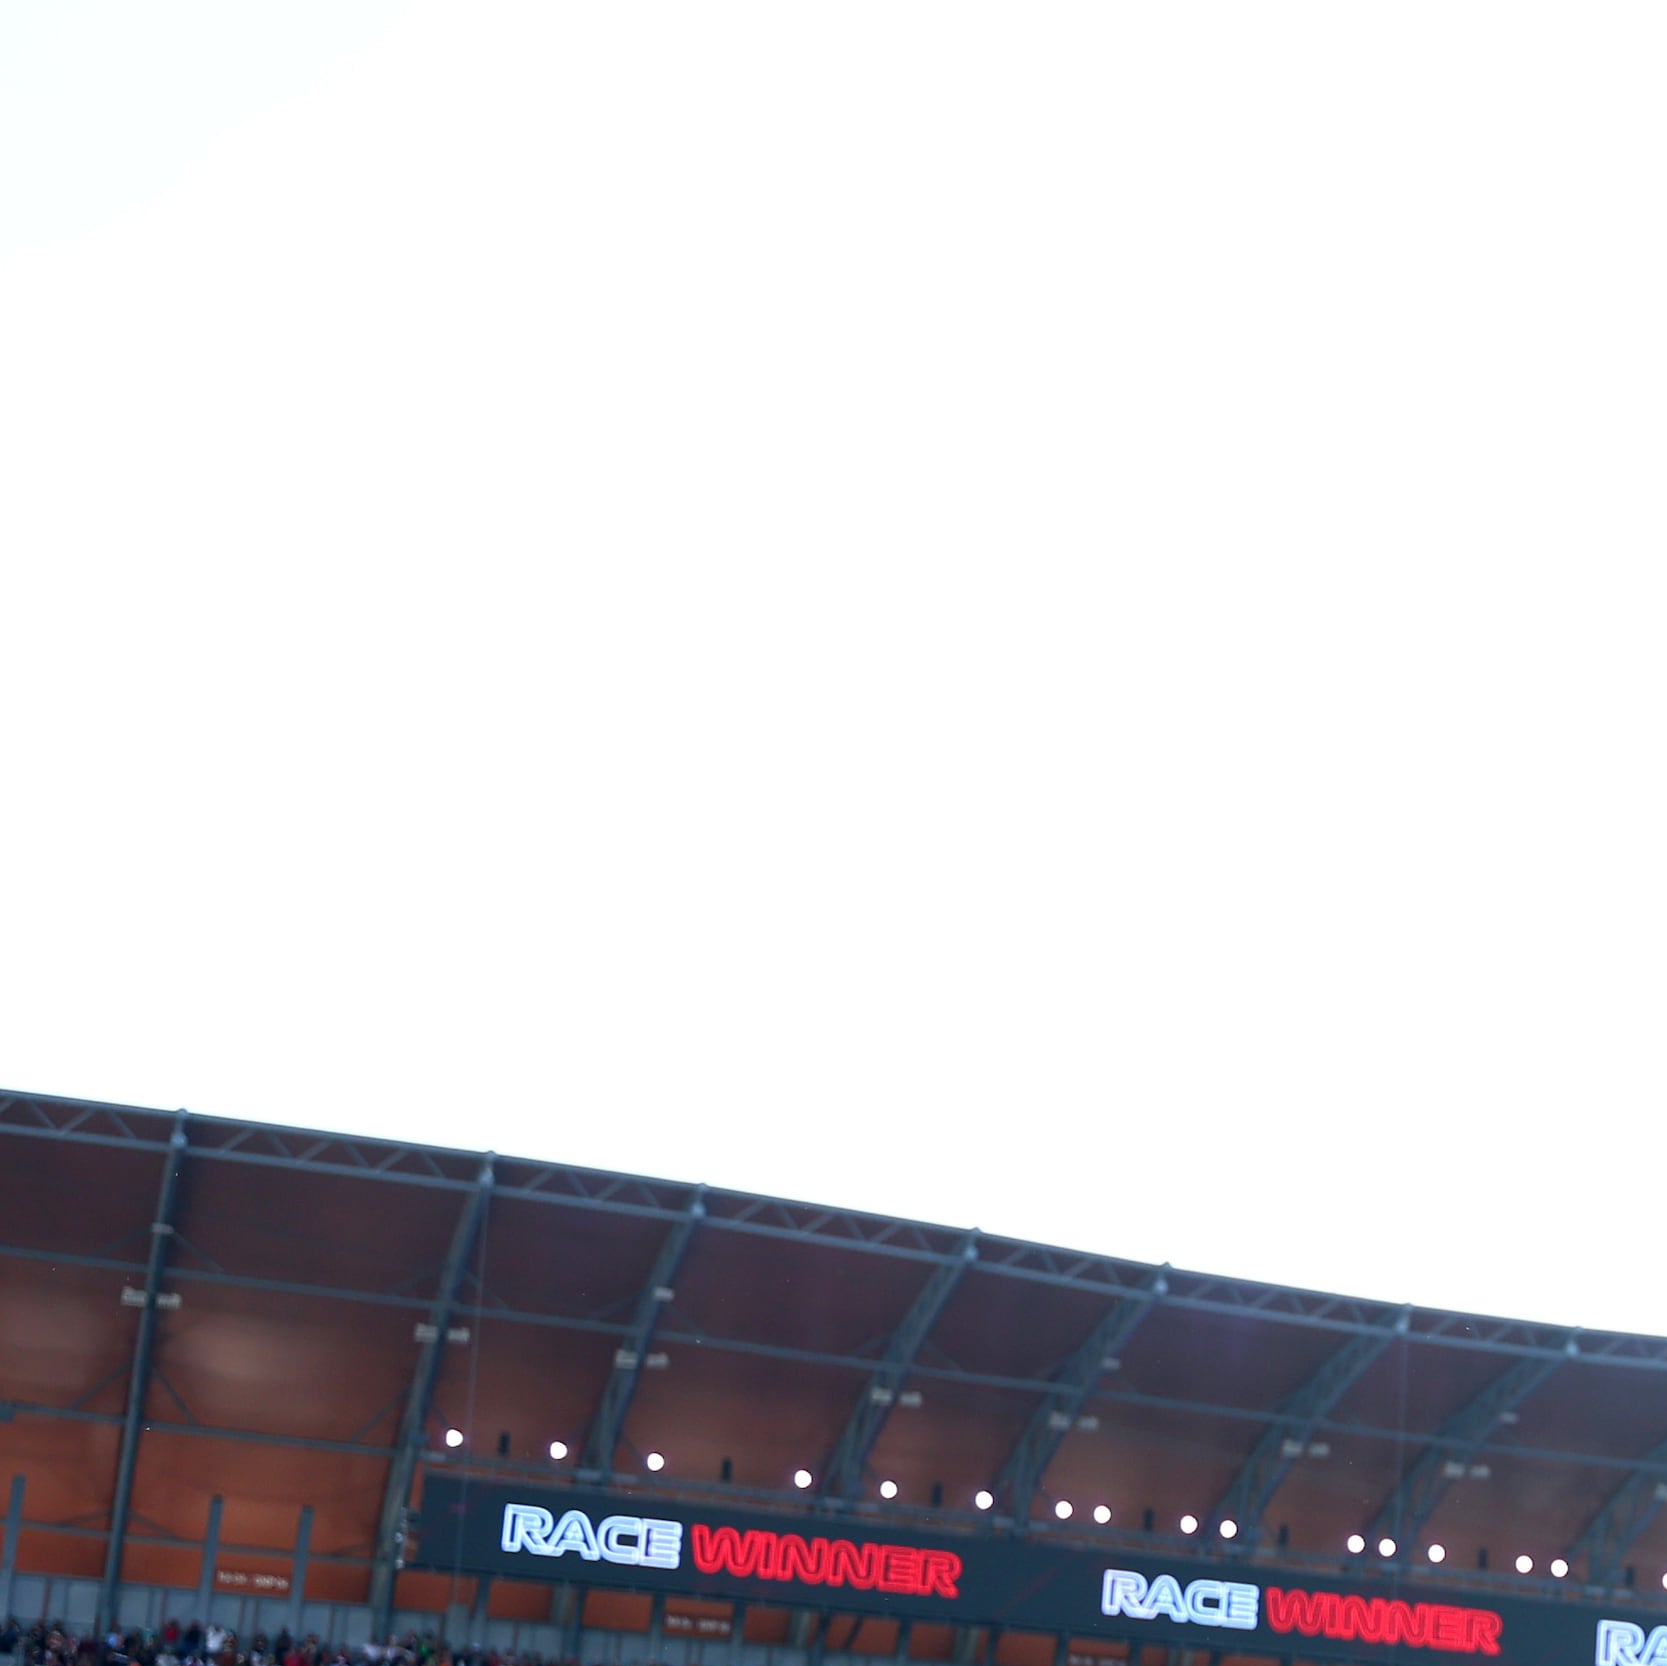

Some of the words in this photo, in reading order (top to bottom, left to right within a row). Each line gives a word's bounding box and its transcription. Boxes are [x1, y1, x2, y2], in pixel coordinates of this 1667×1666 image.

[501, 1502, 683, 1570] RACE
[691, 1523, 963, 1599] WINNER
[1100, 1568, 1260, 1631] RACE
[1265, 1586, 1503, 1656] WINNER
